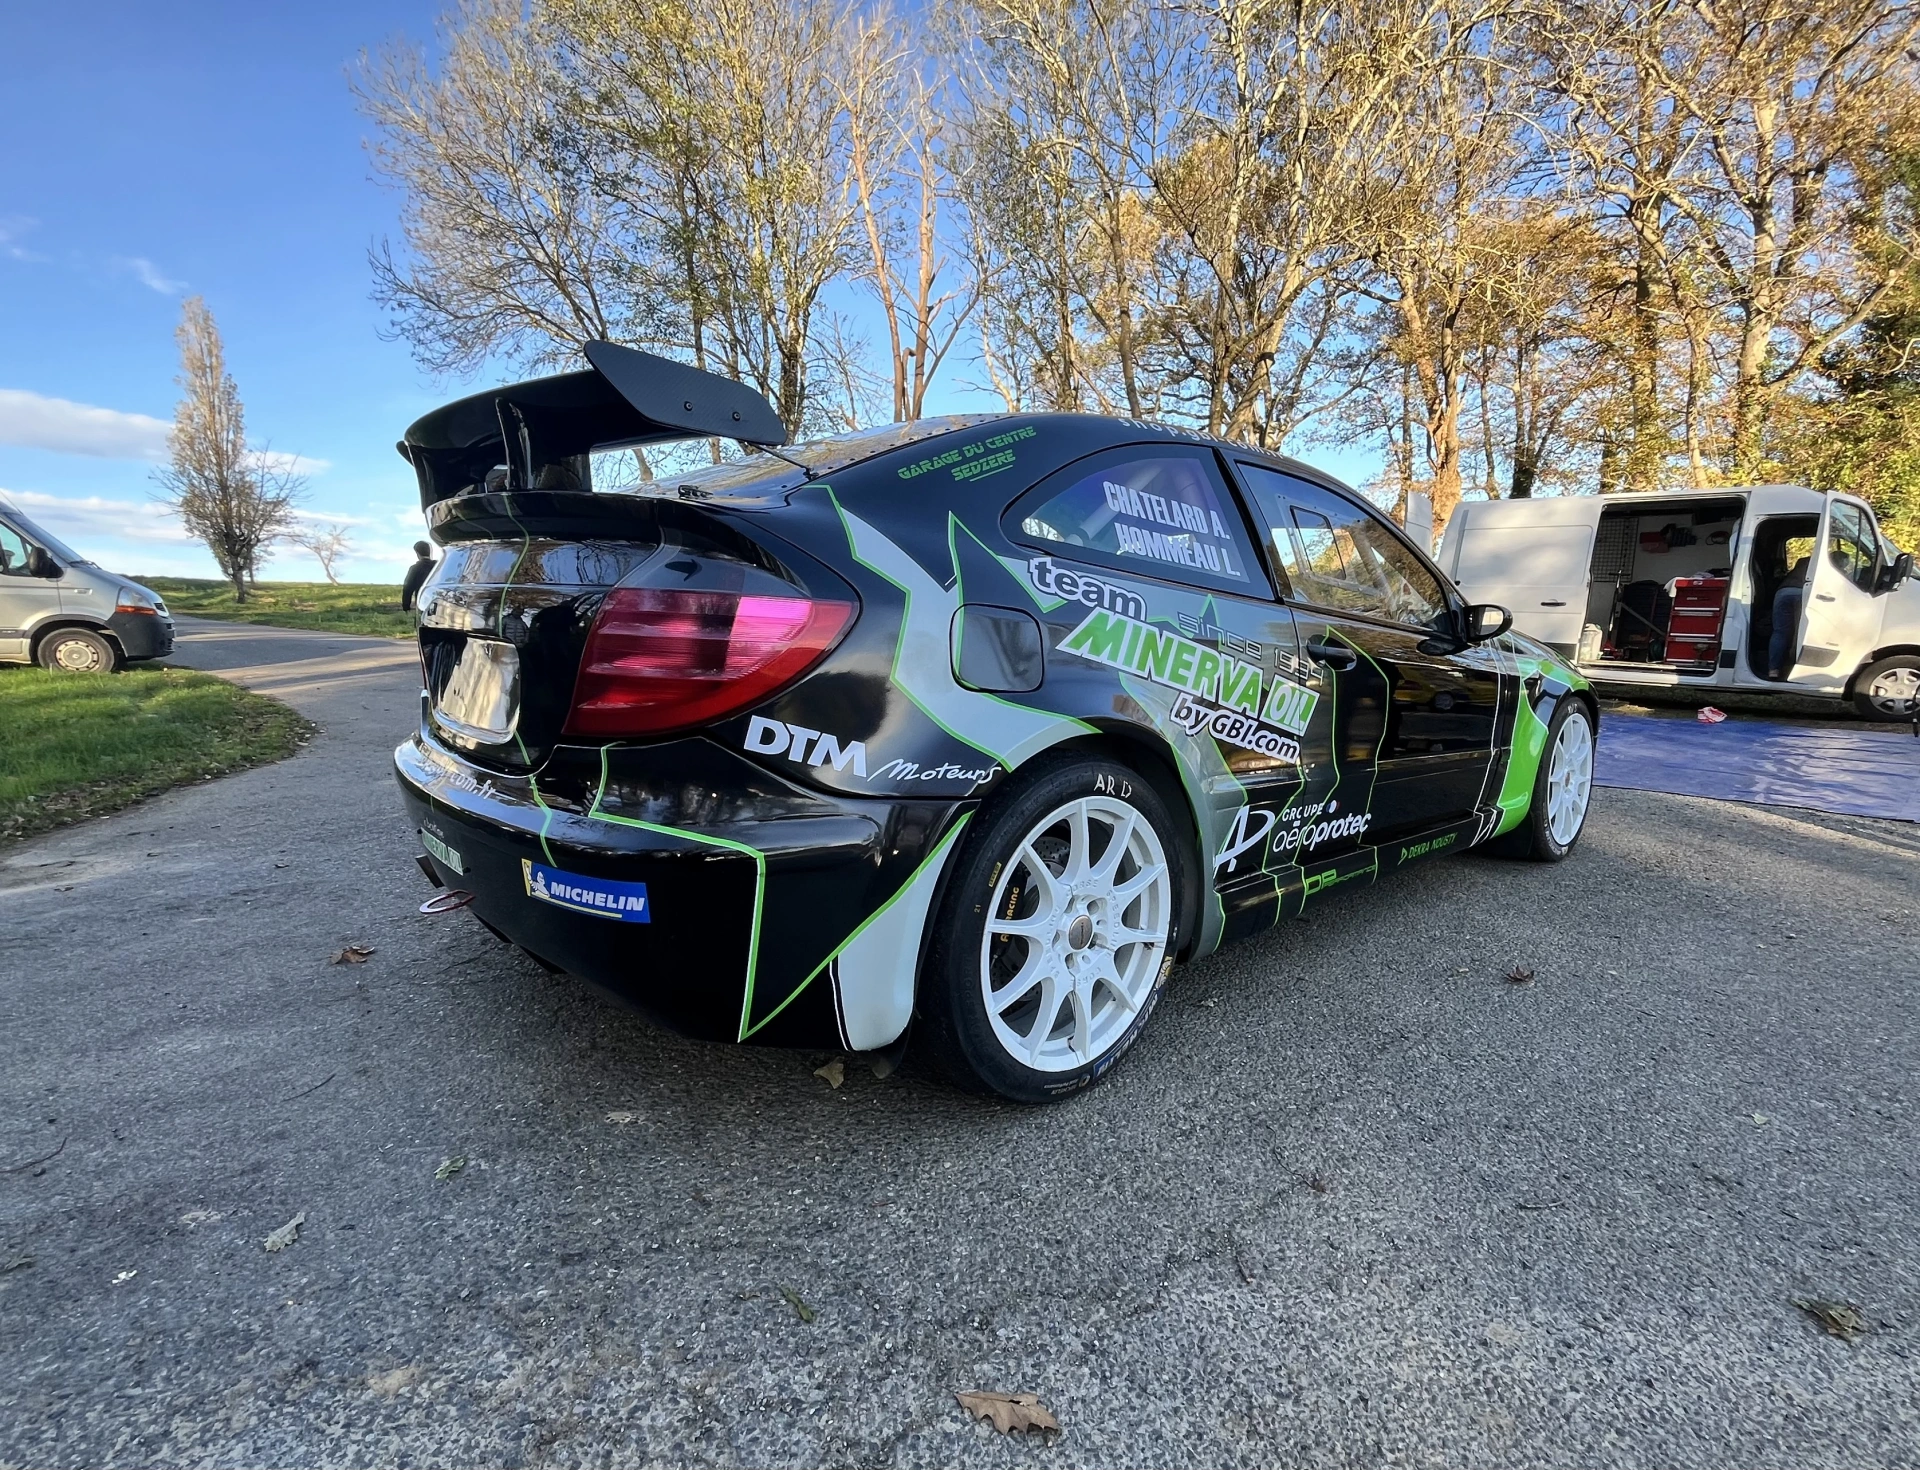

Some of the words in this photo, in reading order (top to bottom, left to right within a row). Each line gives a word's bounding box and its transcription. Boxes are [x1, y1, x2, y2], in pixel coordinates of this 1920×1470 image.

[897, 449, 963, 479] GARAGE
[962, 442, 985, 458] DU
[985, 426, 1037, 449] CENTRE
[951, 449, 1016, 481] SEDZERE
[1103, 481, 1209, 534] CHATELARD
[1210, 510, 1231, 540] A.
[1114, 522, 1221, 572] HOMMEAU
[1222, 547, 1241, 577] L.
[1028, 557, 1146, 622] team
[1057, 608, 1262, 719] MINERVA
[1264, 678, 1314, 733] OIL
[744, 715, 867, 778] DTM
[867, 758, 1001, 784] Moteurs
[1282, 803, 1325, 822] GROUPE
[551, 881, 645, 911] MICHELIN
